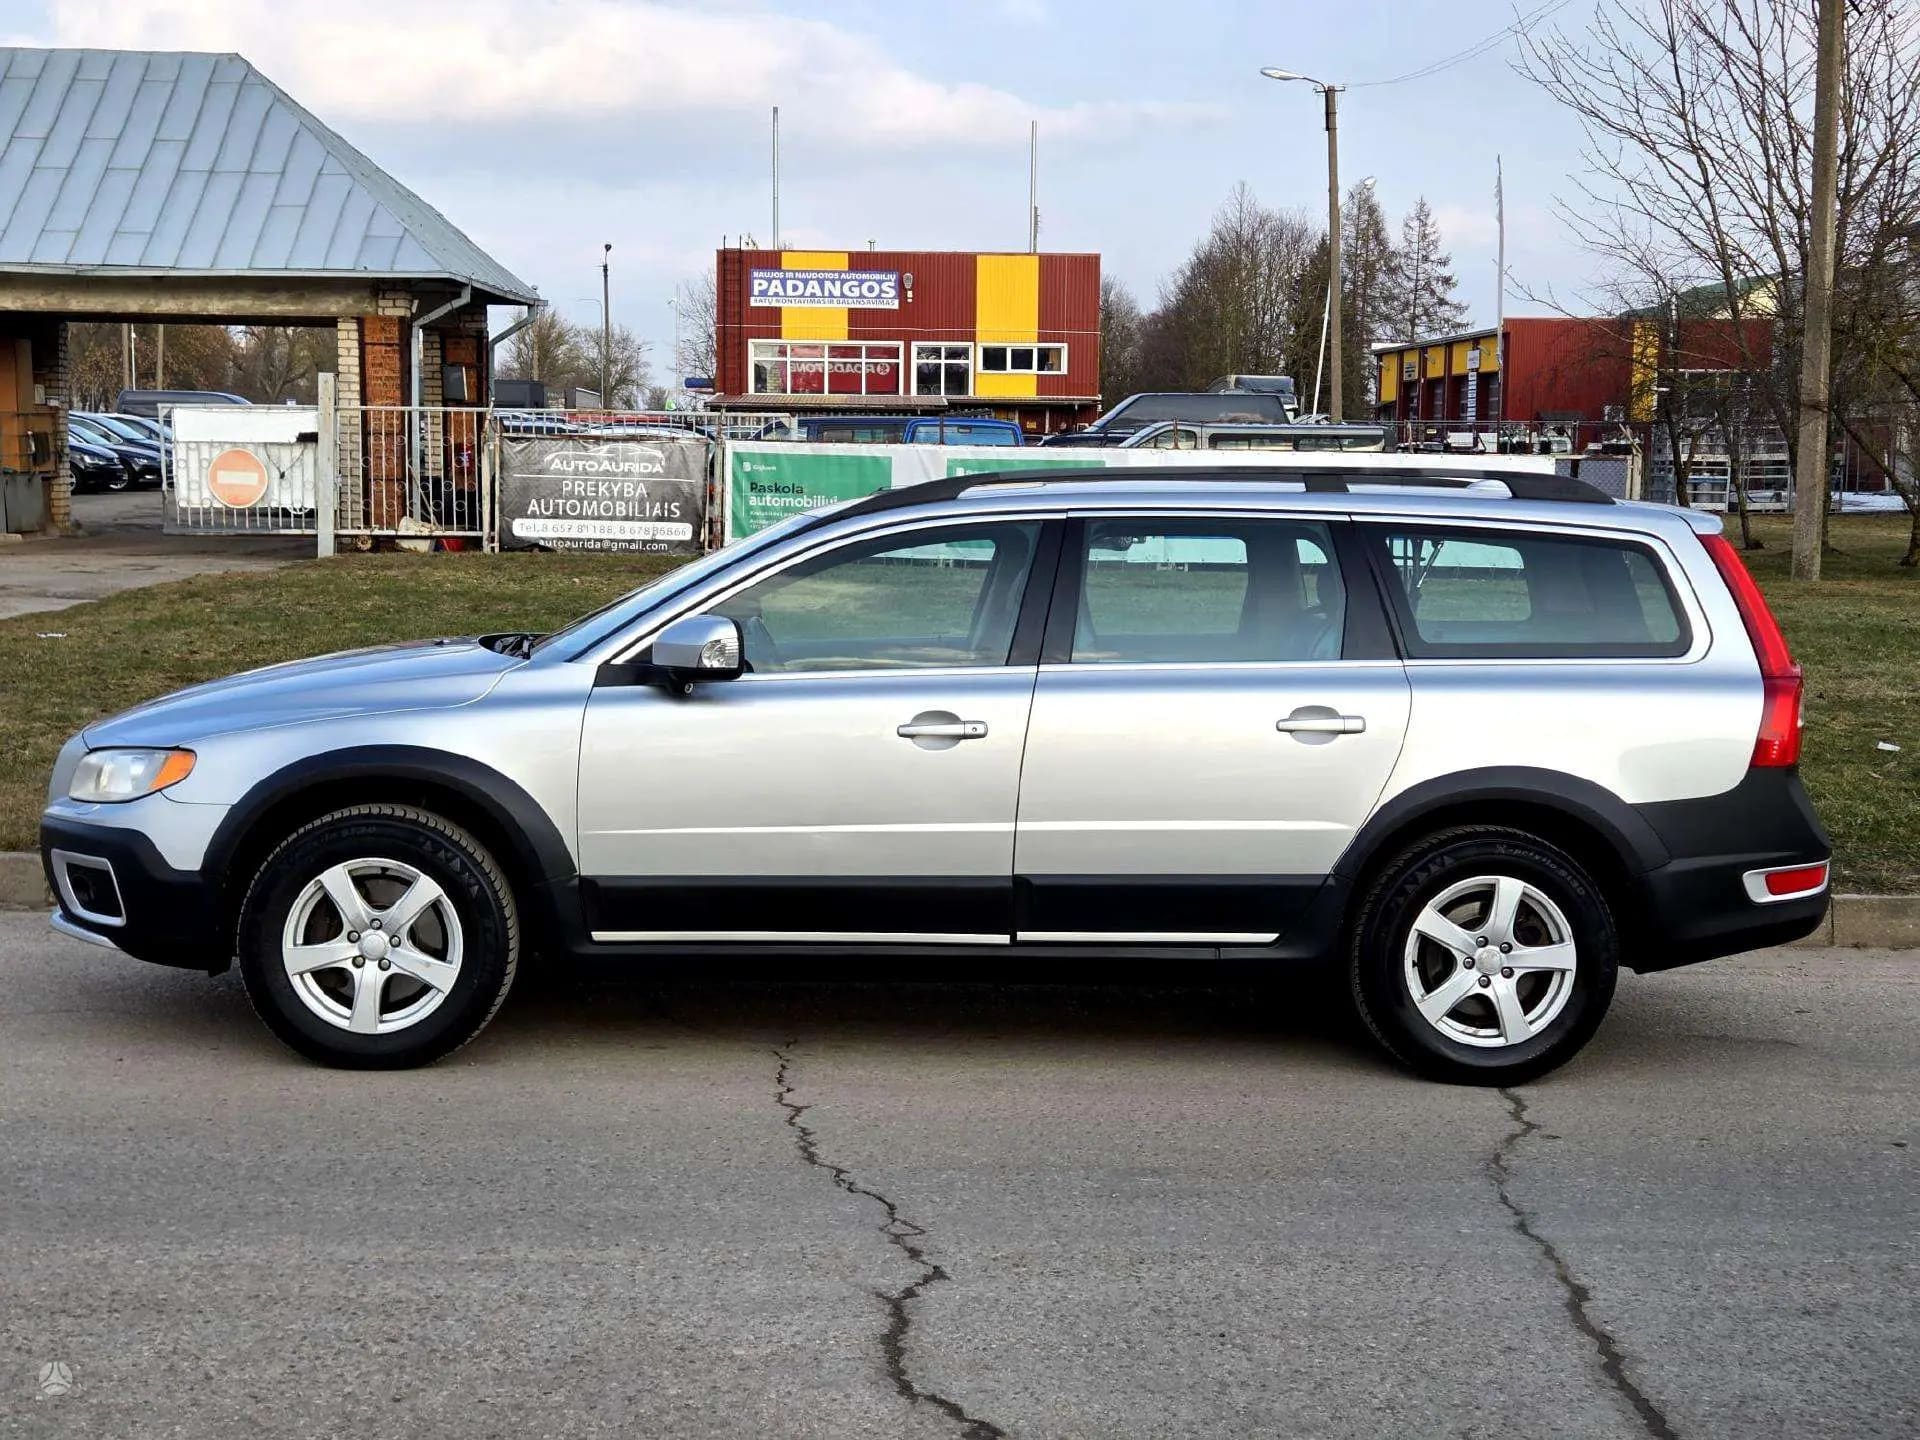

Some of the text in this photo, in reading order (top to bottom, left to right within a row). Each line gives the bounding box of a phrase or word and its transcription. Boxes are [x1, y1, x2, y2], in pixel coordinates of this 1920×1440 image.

[753, 279, 896, 298] PADANGOS
[550, 459, 664, 473] AUTOAURIDA
[562, 480, 648, 498] PREKYBA
[750, 482, 804, 494] Raskola
[527, 498, 681, 518] AUTOMOBILIAIS
[539, 538, 668, 551] autoaurida@gmail.com
